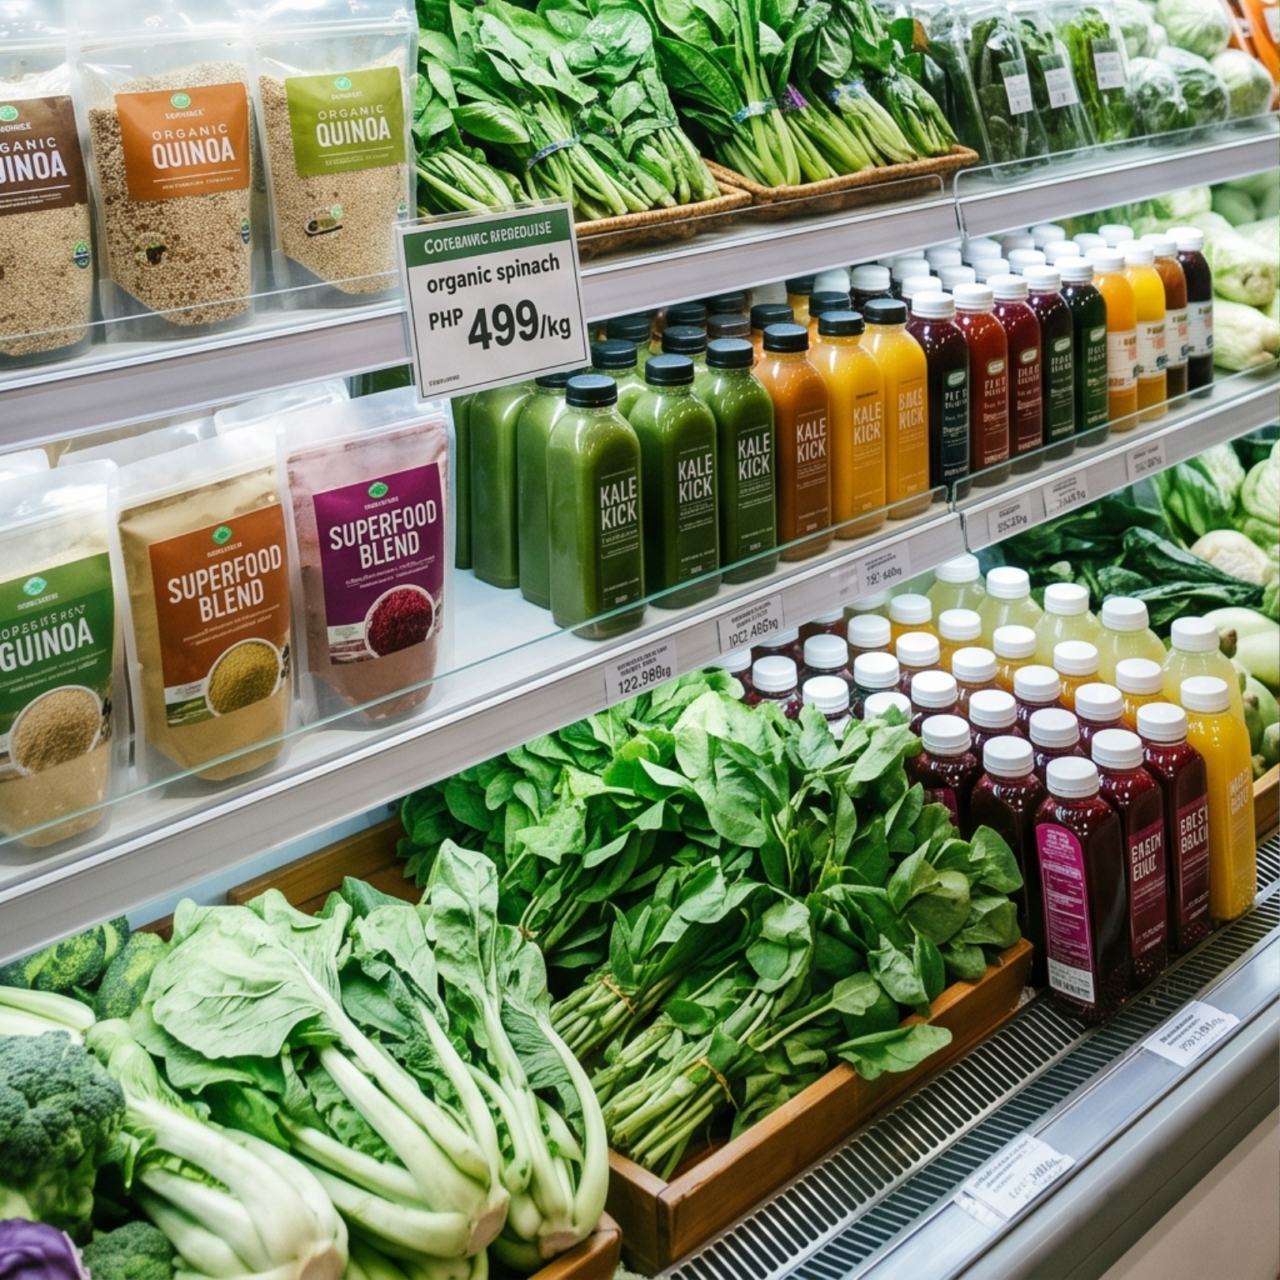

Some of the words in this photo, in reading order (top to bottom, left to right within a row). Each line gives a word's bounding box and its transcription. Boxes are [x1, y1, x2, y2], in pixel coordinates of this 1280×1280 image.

[318, 104, 384, 121] ORGANIC
[152, 123, 228, 141] ORGANIC
[316, 115, 392, 148] QUINOA
[152, 136, 236, 170] QUINOA
[427, 265, 493, 296] organic
[496, 252, 561, 285] spinach
[428, 307, 464, 331] PHP
[467, 299, 572, 351] 499/kg
[853, 402, 882, 426] KALE
[737, 432, 771, 460] KALE
[796, 417, 827, 444] KALE
[796, 437, 826, 464] KICK
[678, 453, 713, 482] KALE
[738, 453, 771, 481] KICK
[600, 475, 637, 509] KALE
[678, 475, 713, 504] KICK
[328, 499, 438, 551] SUPERFOOD
[601, 499, 637, 531] KICK
[358, 530, 420, 570] BLEND
[167, 544, 283, 604] SUPERFOOD
[198, 578, 265, 623] BLEND
